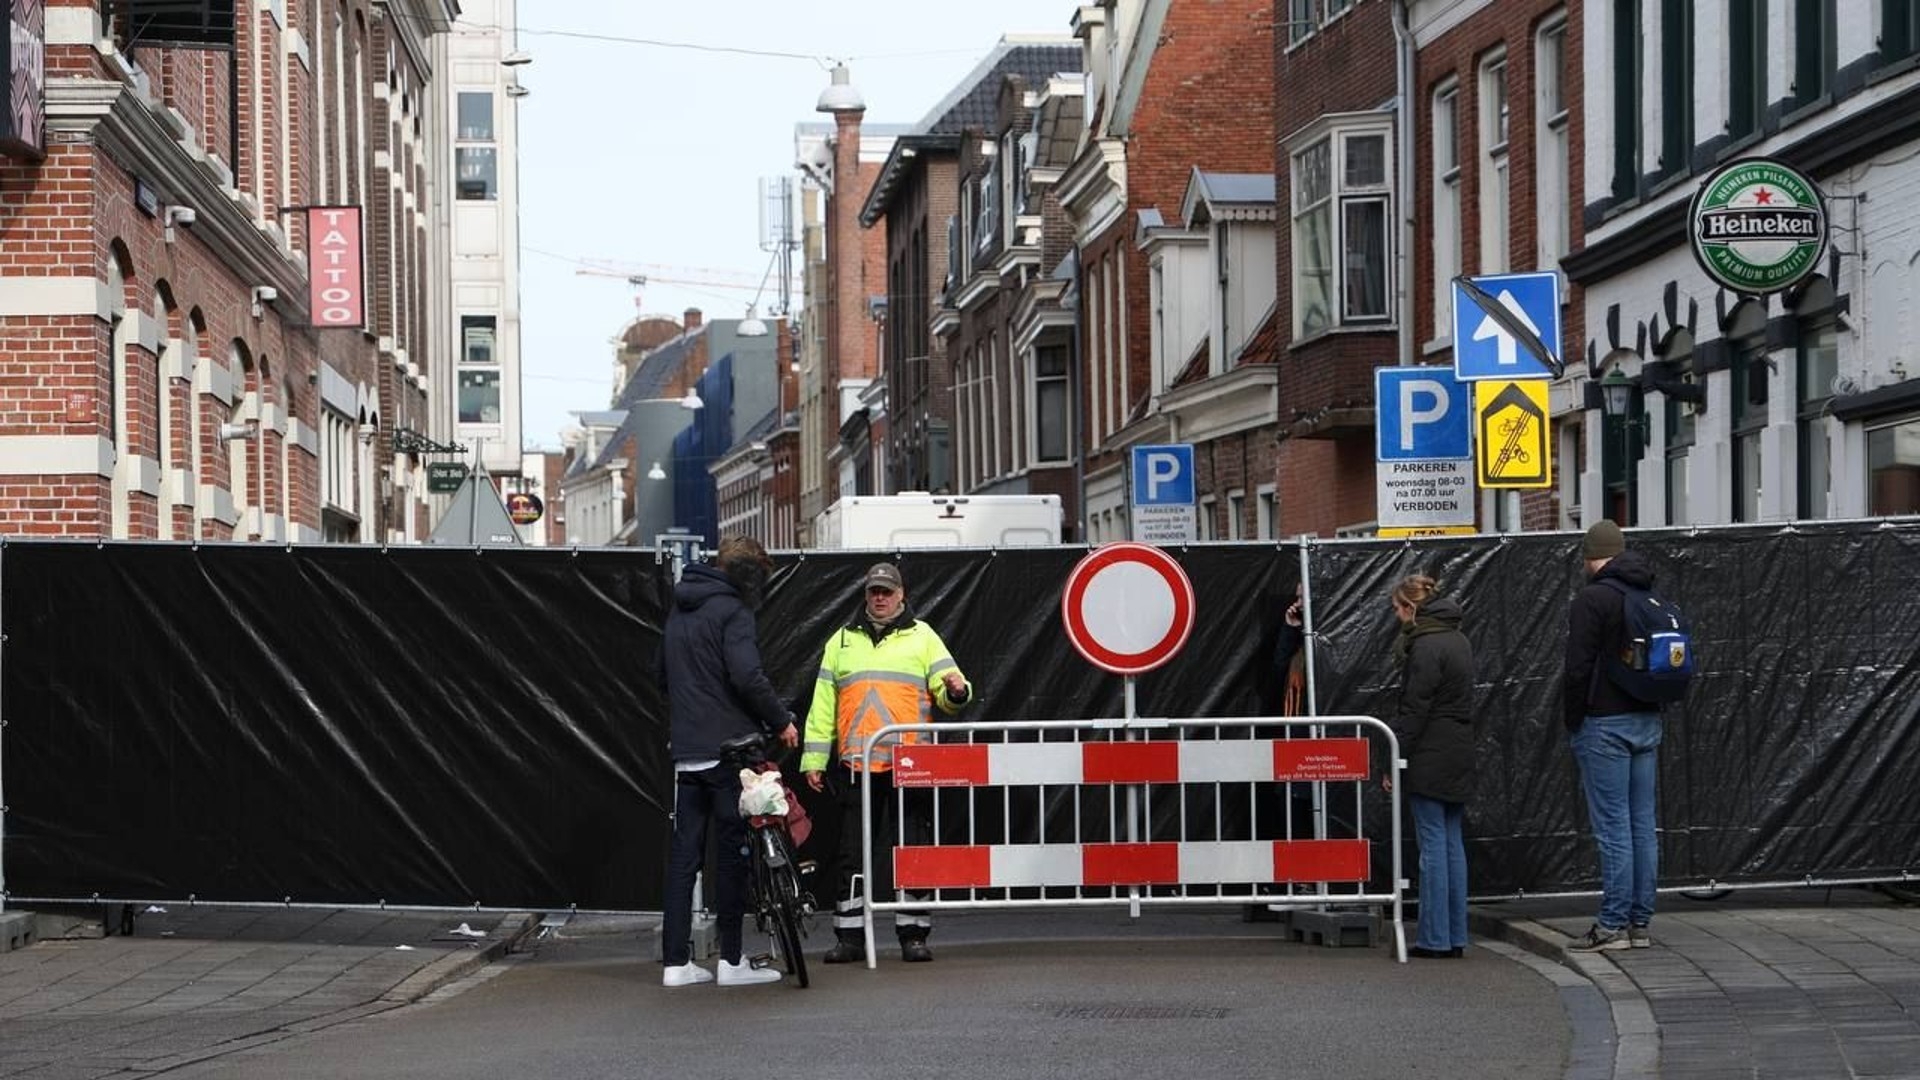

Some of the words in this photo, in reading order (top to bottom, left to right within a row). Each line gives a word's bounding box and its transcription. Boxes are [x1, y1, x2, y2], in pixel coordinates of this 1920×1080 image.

[1716, 170, 1760, 200] HEINEKEN
[1763, 171, 1805, 199] PILSENER
[1708, 214, 1814, 235] Heineken
[321, 211, 351, 322] TATTOO
[1717, 250, 1764, 280] PREMIUM
[1767, 249, 1808, 279] QUALITY
[1400, 380, 1450, 450] P
[1147, 453, 1181, 500] P
[1393, 463, 1457, 473] PARKEREN
[1385, 478, 1436, 488] woensdag
[1437, 477, 1465, 486] 08-03
[1410, 489, 1437, 497] 07.00
[1393, 501, 1458, 511] VERBODEN
